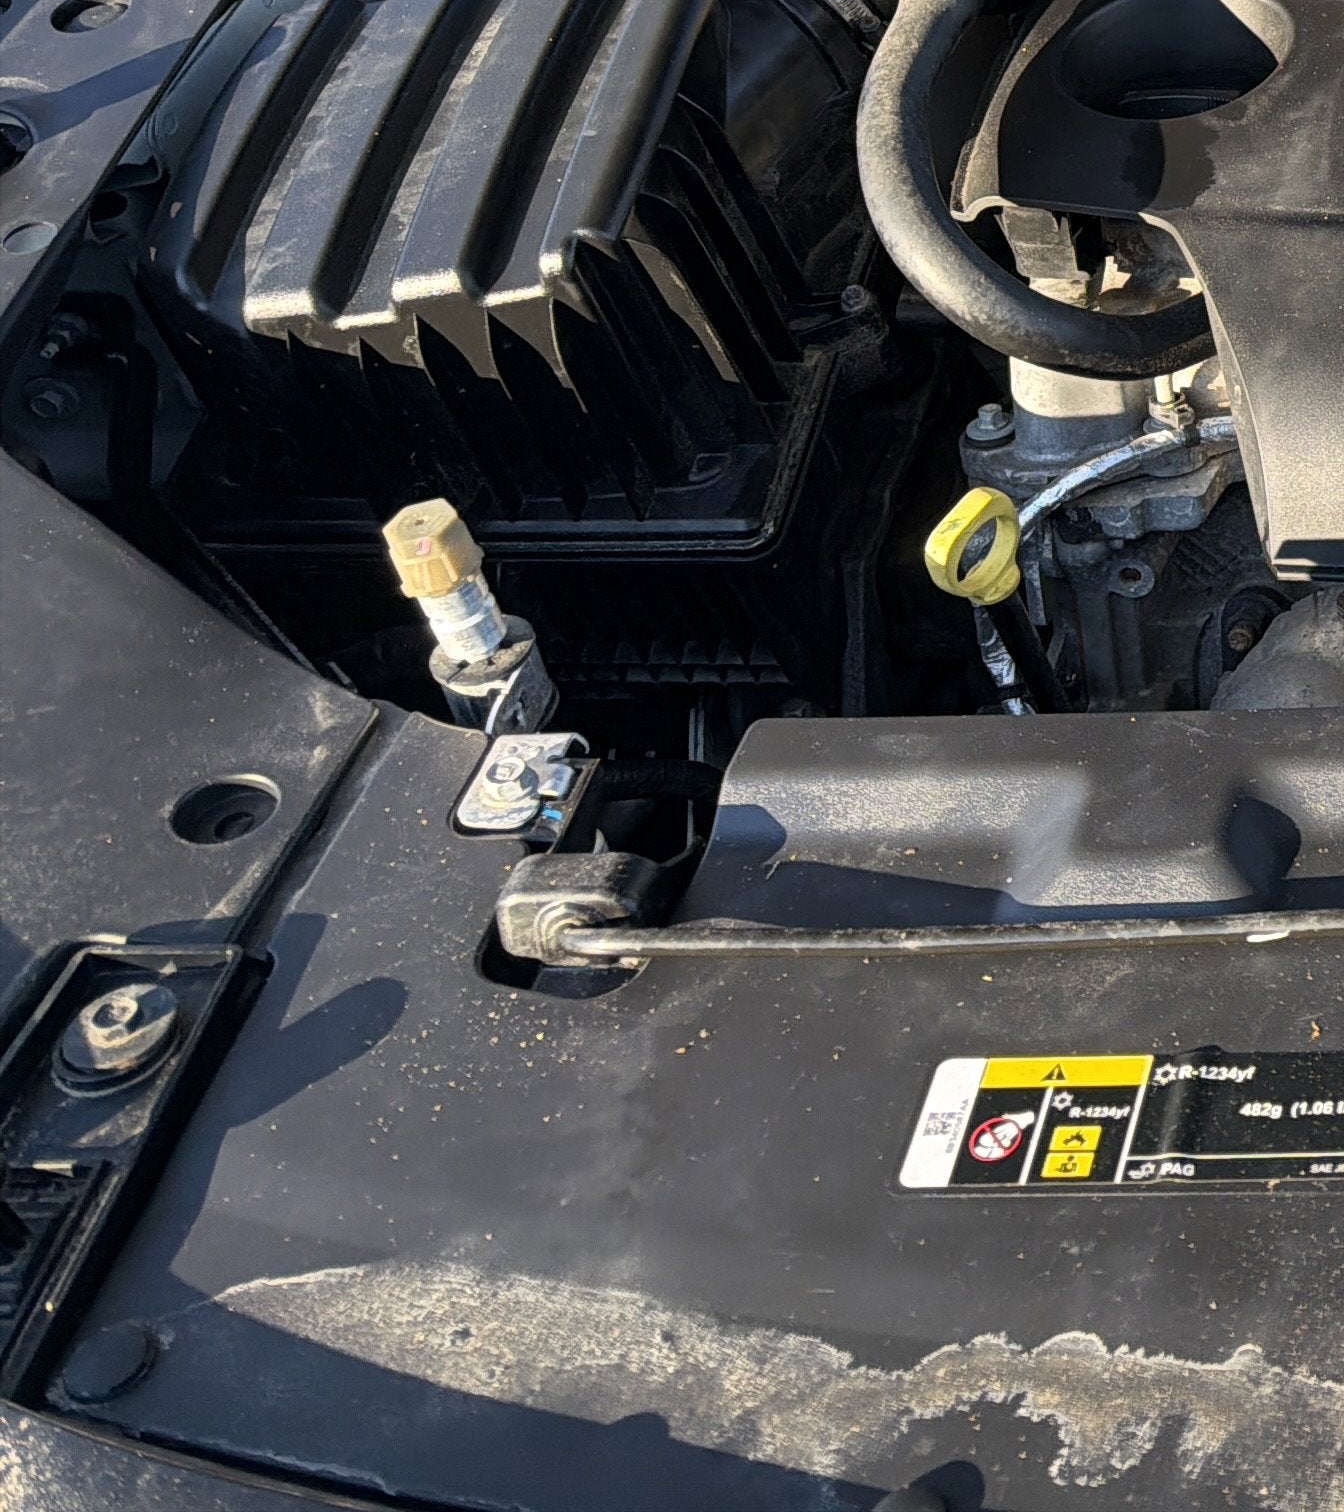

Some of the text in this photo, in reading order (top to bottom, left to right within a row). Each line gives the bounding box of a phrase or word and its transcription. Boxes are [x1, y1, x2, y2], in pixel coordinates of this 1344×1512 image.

[1177, 1064, 1257, 1083] R-1234yf
[1068, 1105, 1131, 1120] R-1234yf
[1239, 1101, 1283, 1120] 482g
[1290, 1100, 1334, 1119] (1.06
[1159, 1161, 1196, 1177] PAG
